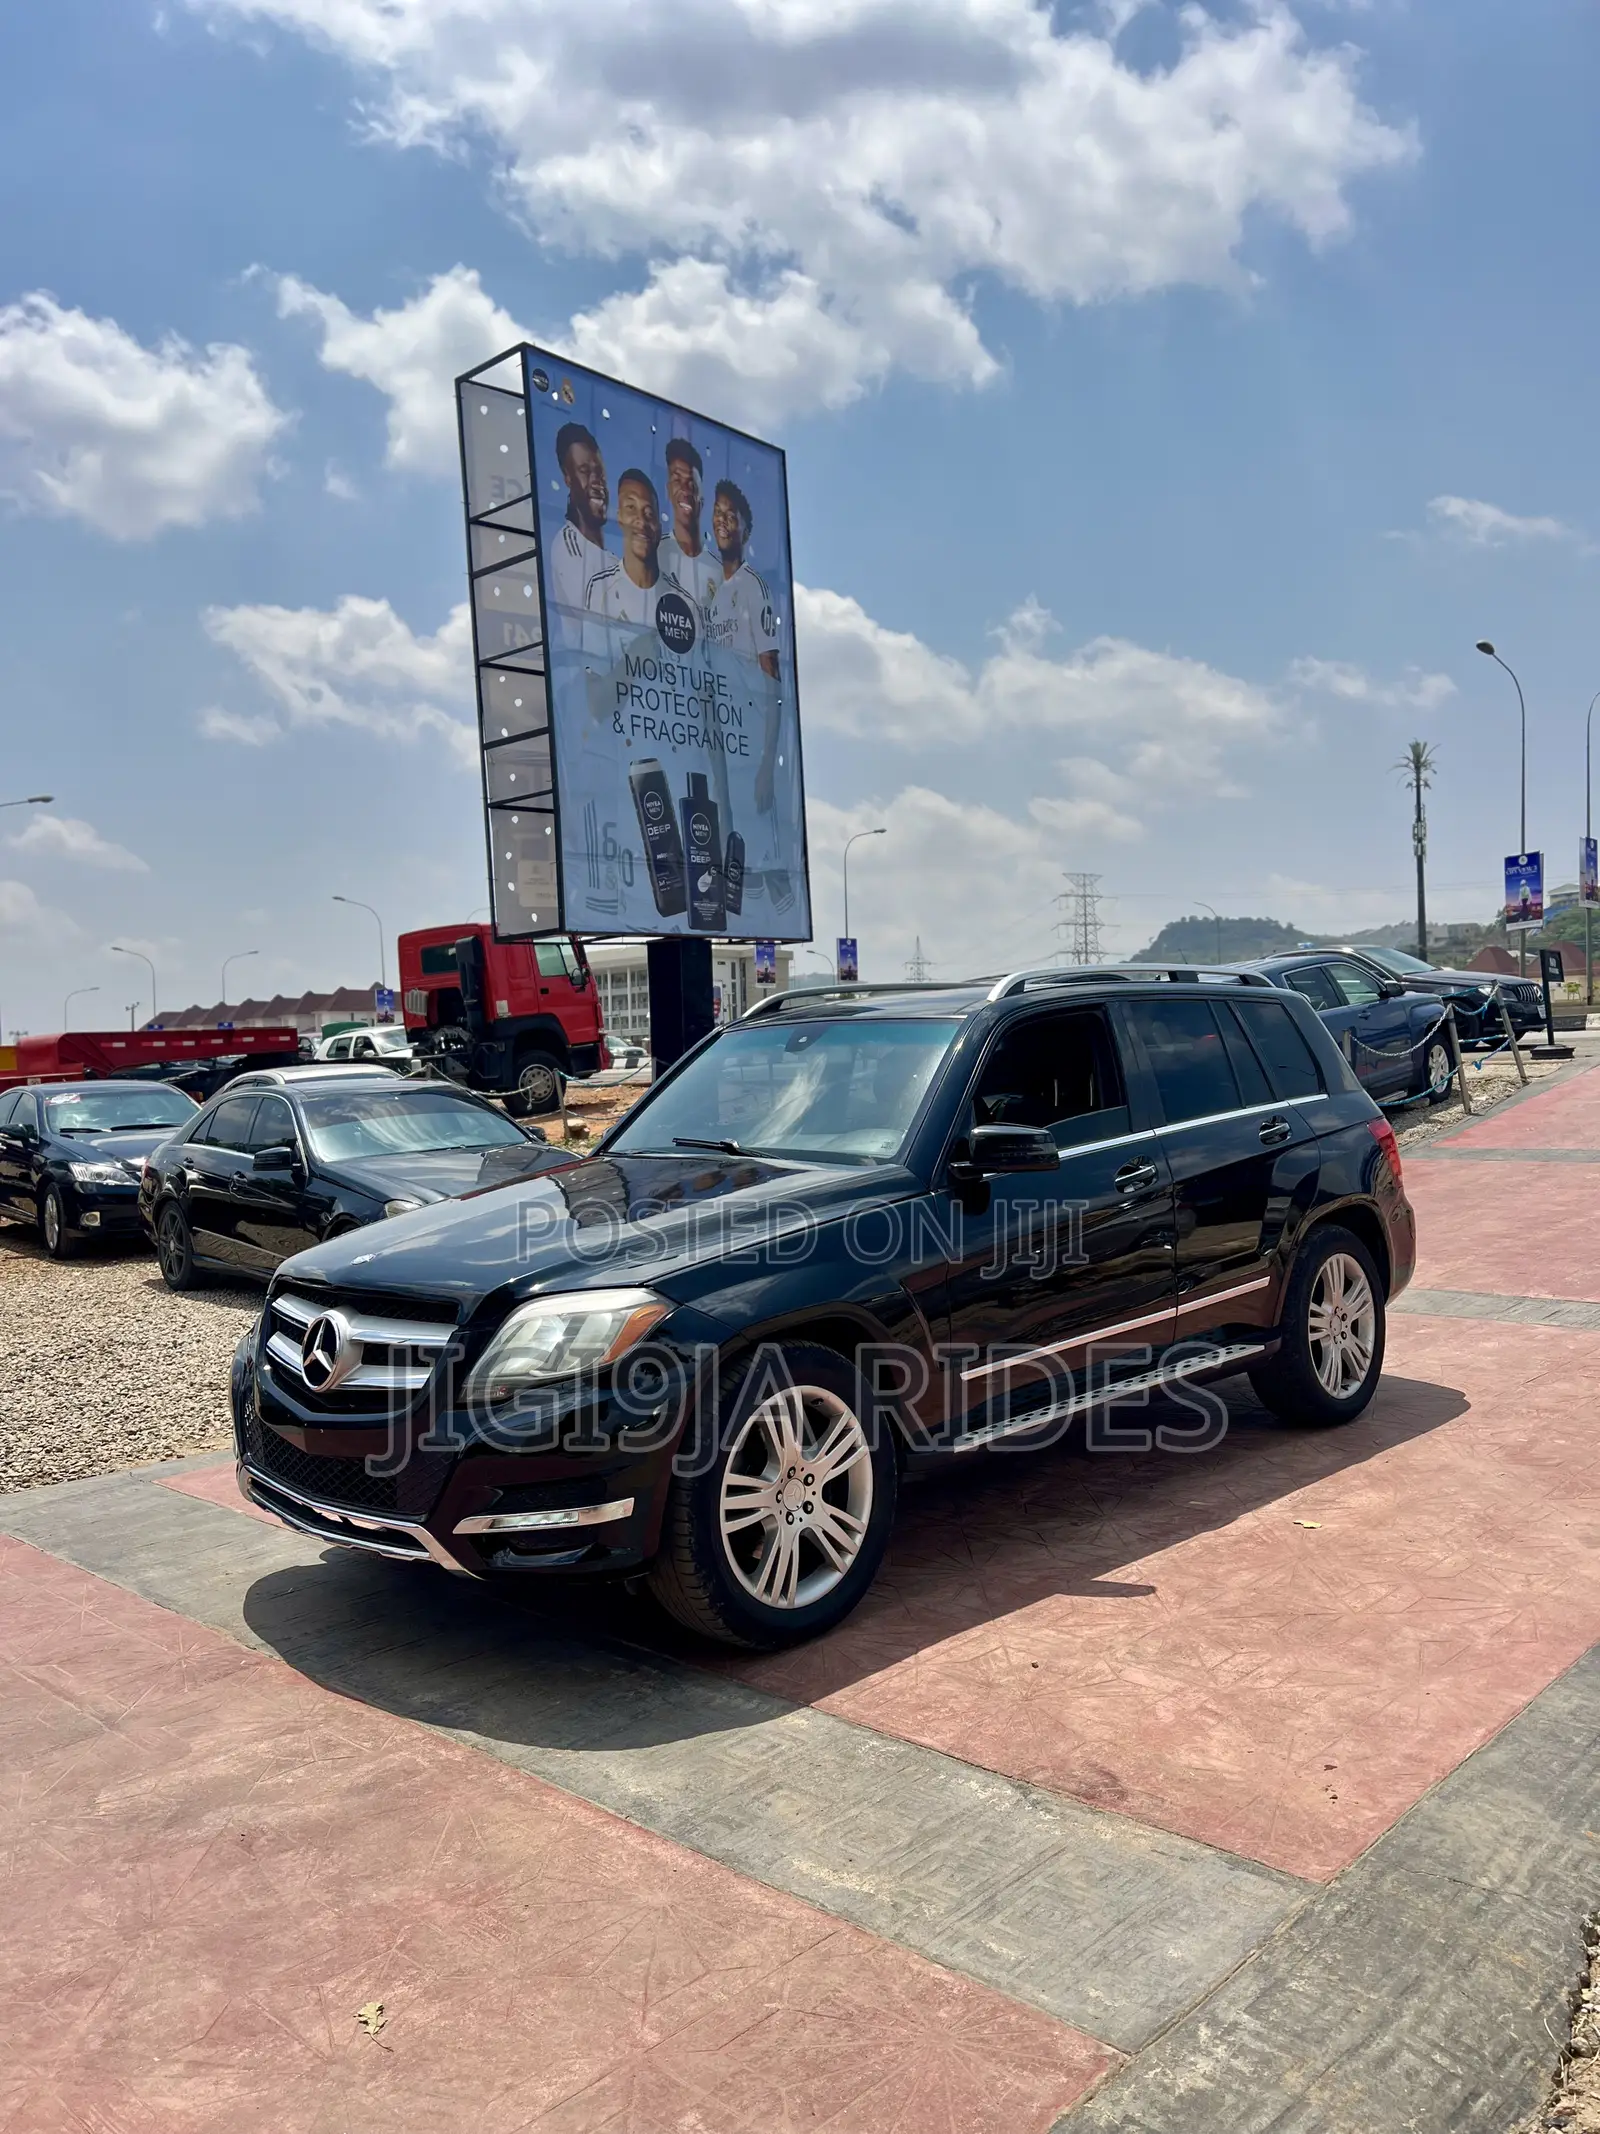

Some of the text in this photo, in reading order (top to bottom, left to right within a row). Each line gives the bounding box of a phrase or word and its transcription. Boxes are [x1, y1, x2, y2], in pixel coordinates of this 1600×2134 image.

[660, 610, 692, 630] NIVEA
[664, 624, 690, 641] MEN
[624, 653, 733, 702] MOISTURE,
[616, 681, 743, 728] PROTECTION
[612, 710, 750, 756] & FRAGRANCE
[647, 823, 671, 836] DEEP
[692, 823, 709, 832] NIVEA
[690, 854, 711, 864] DEEP
